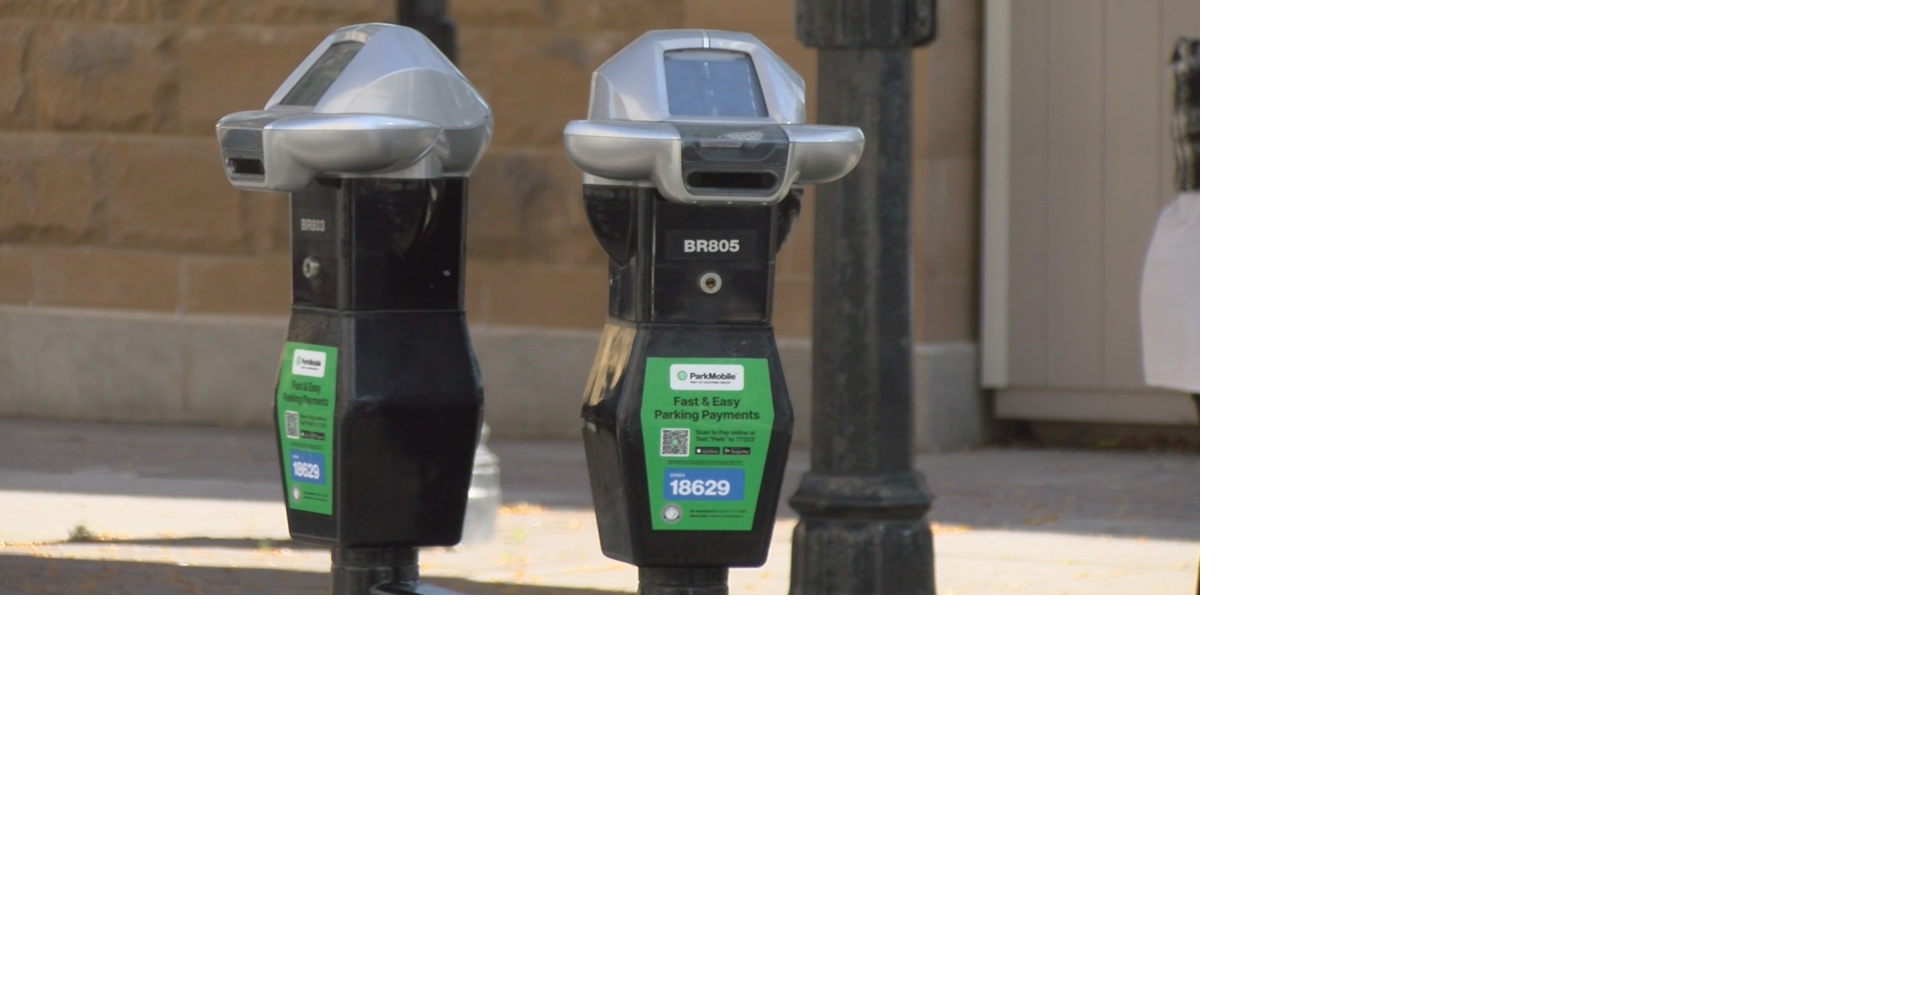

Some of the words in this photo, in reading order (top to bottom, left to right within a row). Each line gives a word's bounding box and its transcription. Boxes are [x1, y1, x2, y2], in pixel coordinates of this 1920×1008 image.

[683, 239, 740, 253] BR805
[689, 372, 736, 380] ParkMobile
[673, 396, 699, 407] Fast
[701, 396, 710, 407] &
[712, 397, 741, 408] Easy
[654, 409, 699, 422] Parking
[701, 410, 760, 422] Payments
[292, 461, 320, 480] 18629
[669, 479, 731, 496] 18629
